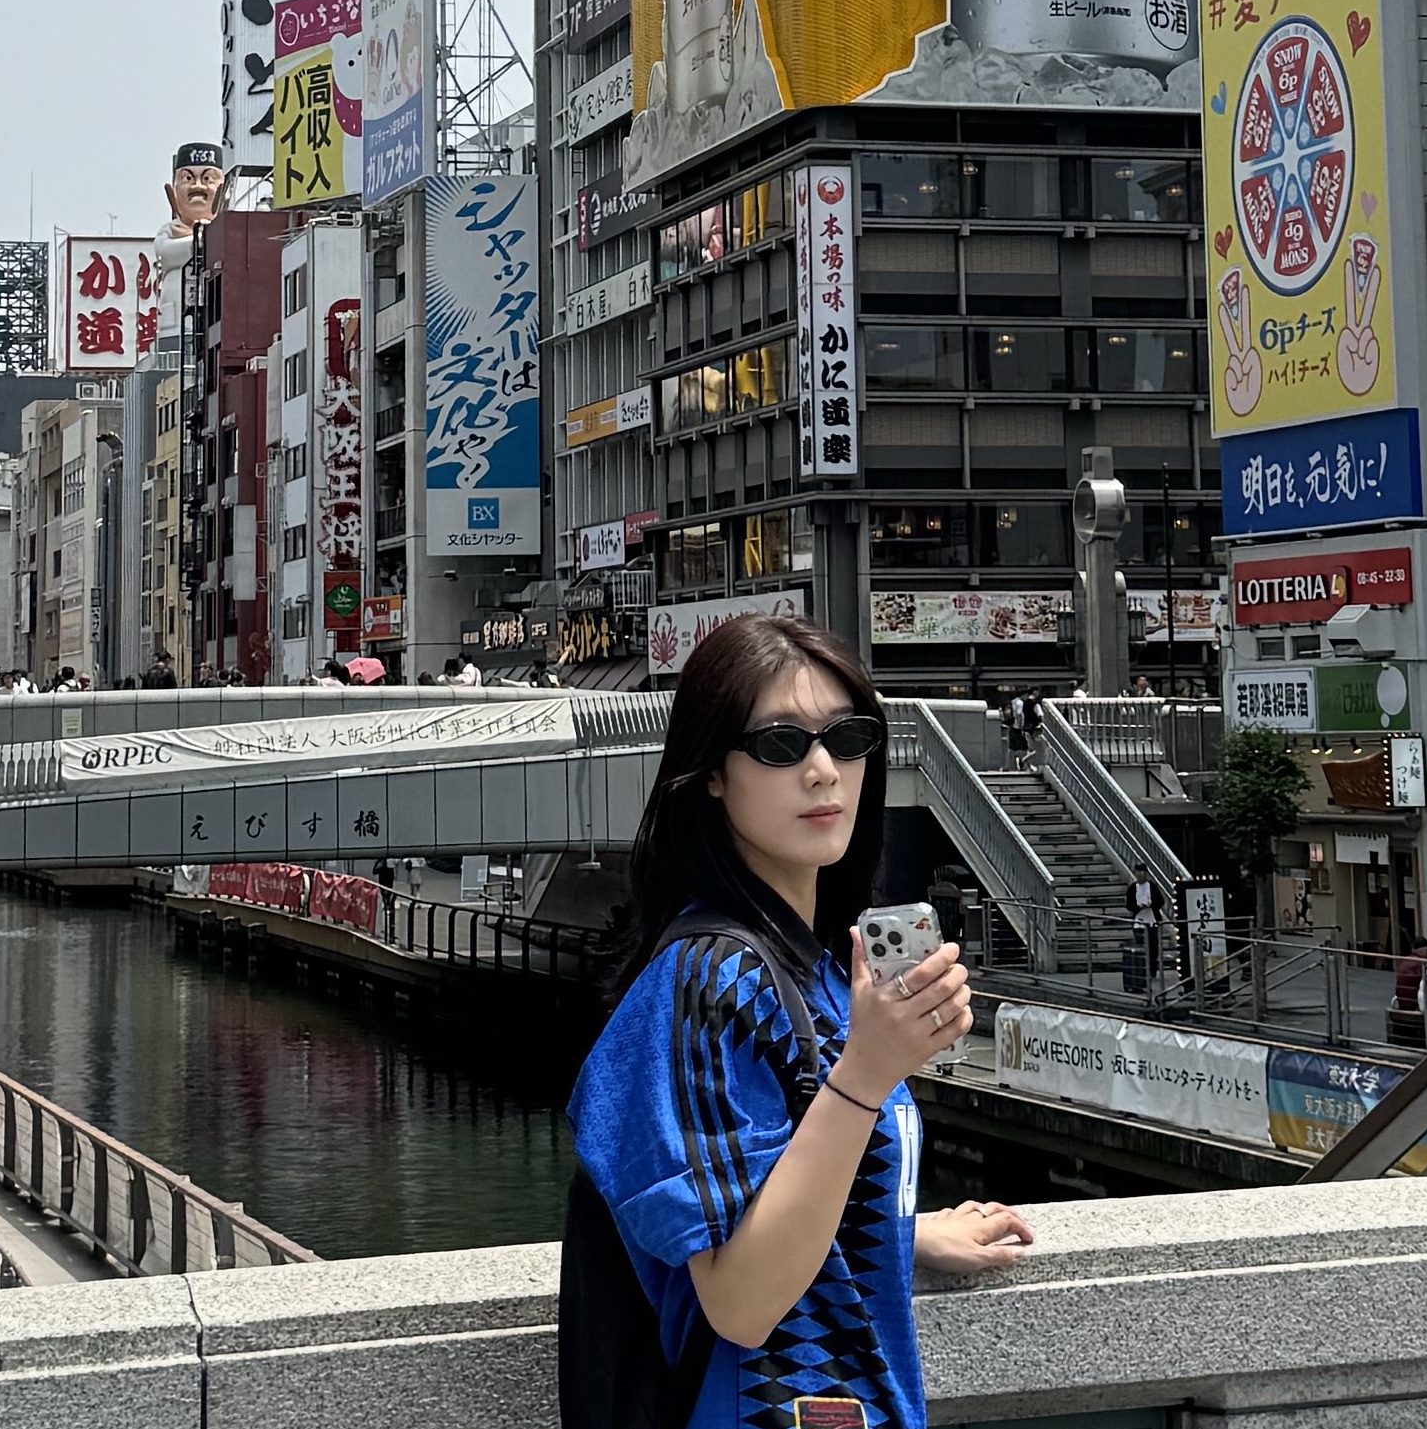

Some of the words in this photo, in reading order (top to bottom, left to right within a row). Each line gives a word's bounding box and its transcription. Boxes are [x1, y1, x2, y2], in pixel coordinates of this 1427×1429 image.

[1049, 0, 1100, 18] 生ビール
[1273, 42, 1304, 67] SNOW
[279, 68, 307, 200] バイト
[306, 63, 332, 194] 高収入
[819, 213, 845, 313] 本場の味
[575, 290, 607, 329] 白木屋
[818, 323, 852, 464] かに道楽
[318, 375, 362, 560] 大阪王将
[472, 504, 496, 523] BX
[447, 532, 524, 547] 文化シャッター
[1237, 573, 1327, 605] LOTTERIA
[189, 809, 381, 841] えびす橋
